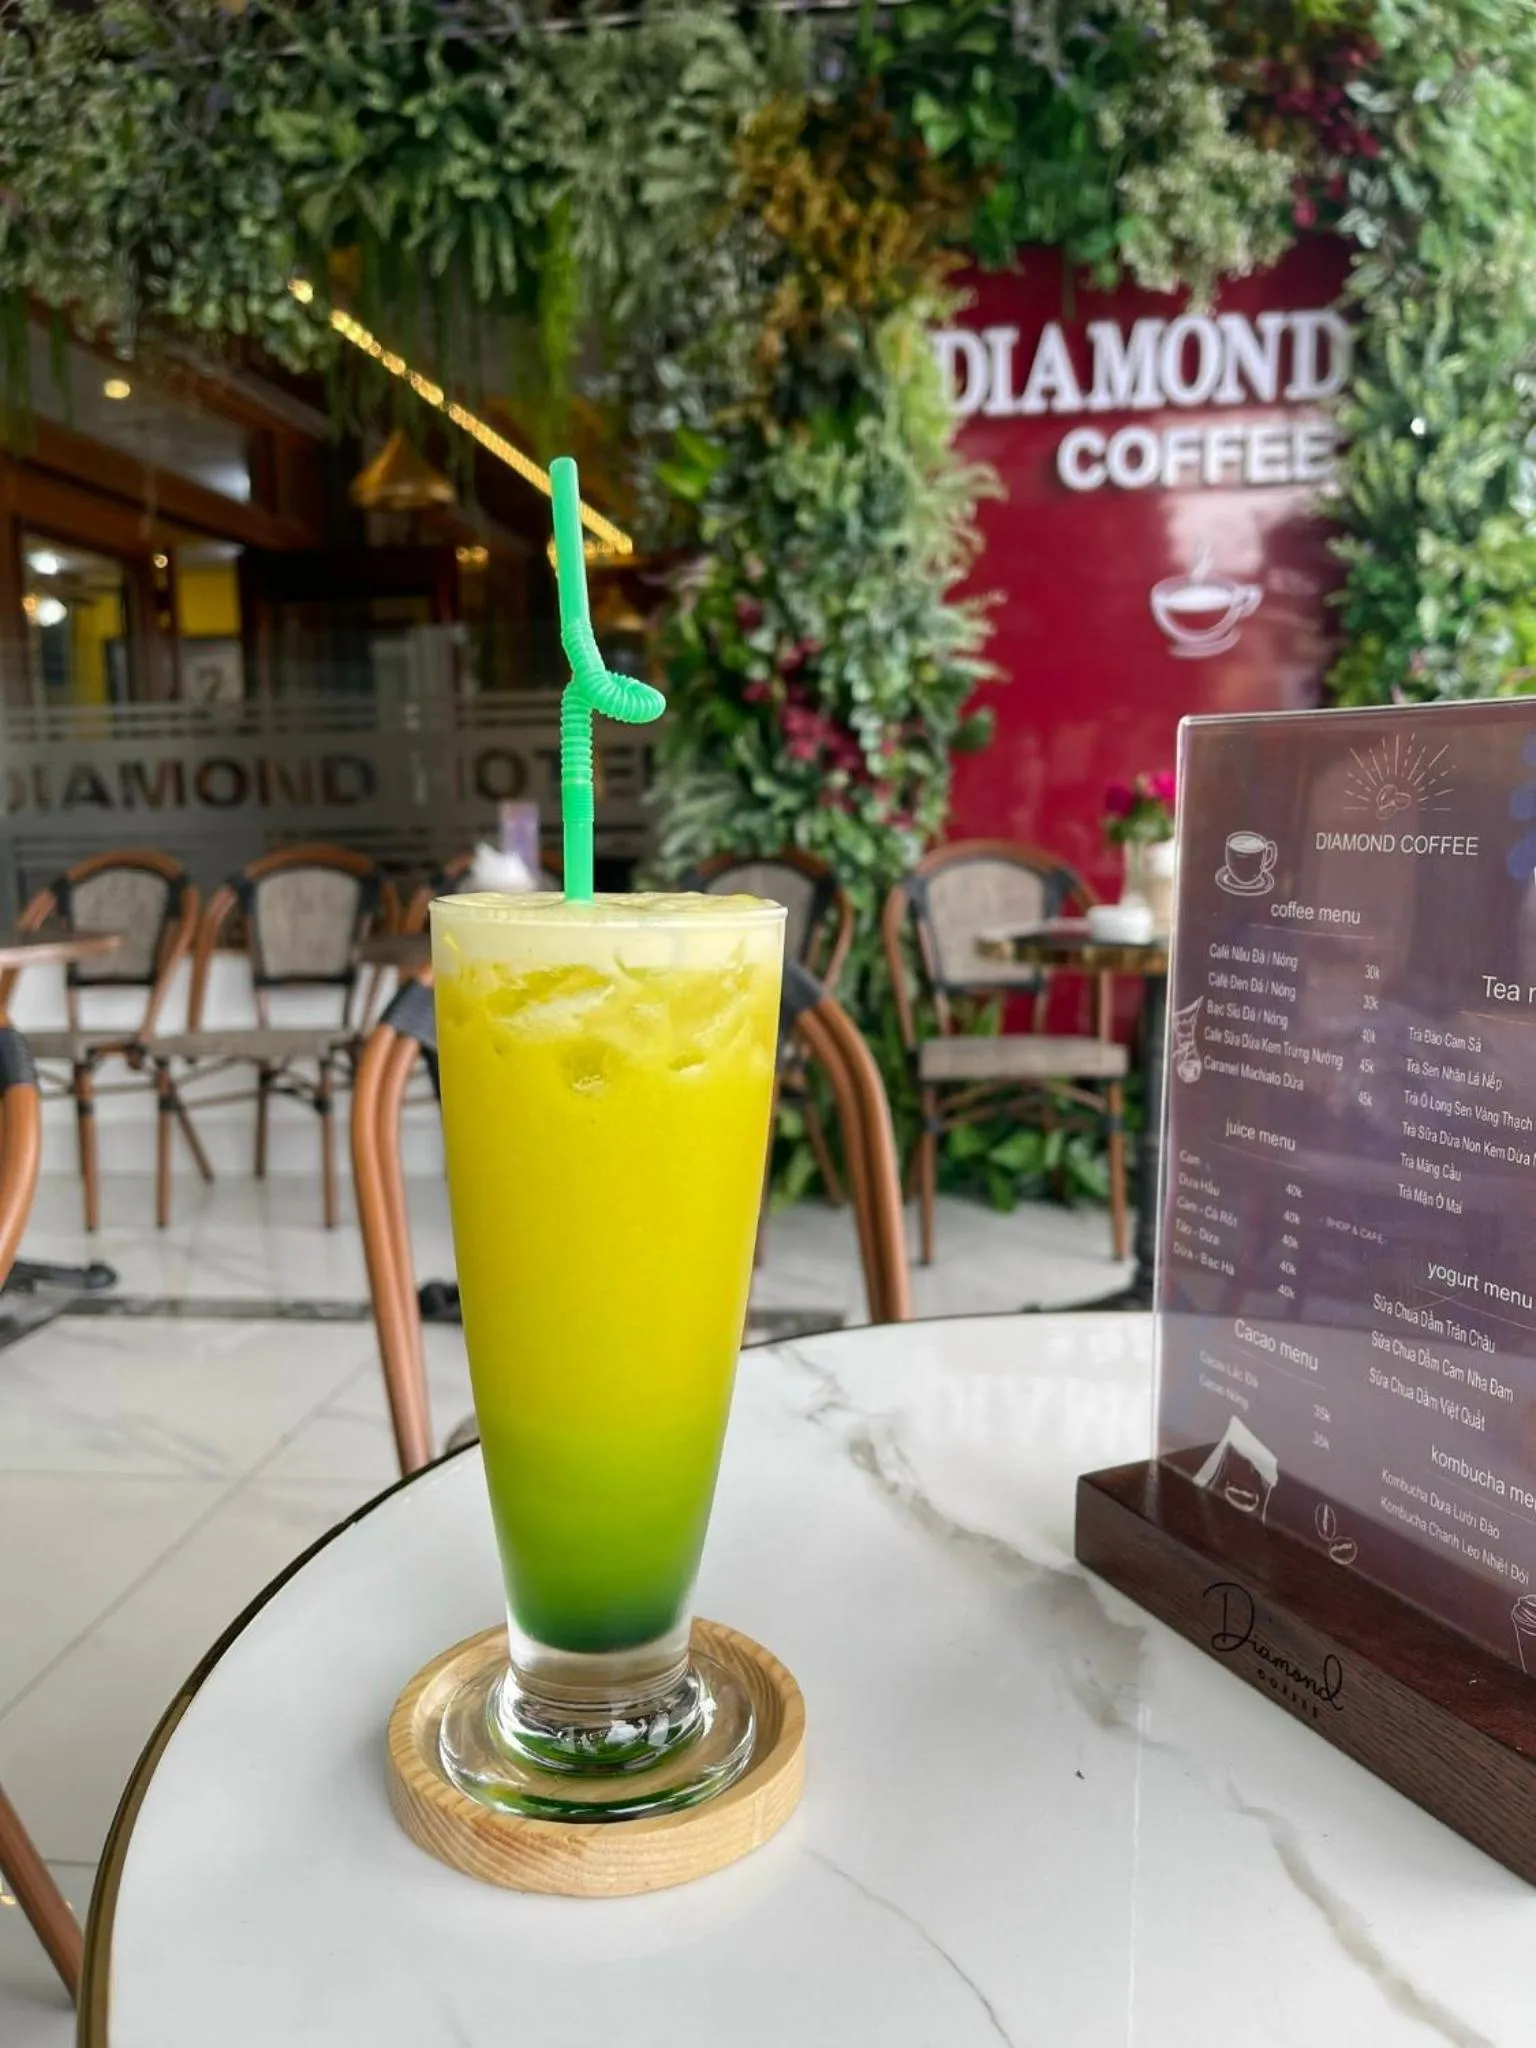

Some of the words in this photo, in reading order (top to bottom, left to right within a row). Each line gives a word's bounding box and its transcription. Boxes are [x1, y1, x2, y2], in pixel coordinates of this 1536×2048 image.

[931, 309, 1352, 417] DIAMOND
[1057, 422, 1336, 491] COFFEE
[1315, 833, 1395, 852] DIAMOND
[1401, 835, 1479, 856] COFFEE
[1271, 902, 1314, 920] coffee
[1319, 907, 1361, 925] menu
[1482, 975, 1519, 1001] Tea
[1422, 1062, 1440, 1078] Sen
[1430, 1096, 1452, 1117] Long
[1454, 1101, 1472, 1118] Sen
[1226, 1118, 1255, 1140] juice
[1259, 1129, 1296, 1151] menu
[1483, 1140, 1505, 1159] Kem
[1428, 1262, 1479, 1291] yogurt
[1484, 1281, 1533, 1310] menu
[1235, 1318, 1276, 1352] Cacao
[1280, 1341, 1319, 1371] menu
[1442, 1358, 1465, 1383] Cam
[1381, 1468, 1428, 1503] Kombucha
[1431, 1444, 1505, 1495] kombucha
[1381, 1496, 1427, 1531] Kombucha
[1428, 1521, 1459, 1549] Chanh
[1461, 1538, 1480, 1560] Leo
[1203, 1582, 1344, 1711] Diamond
